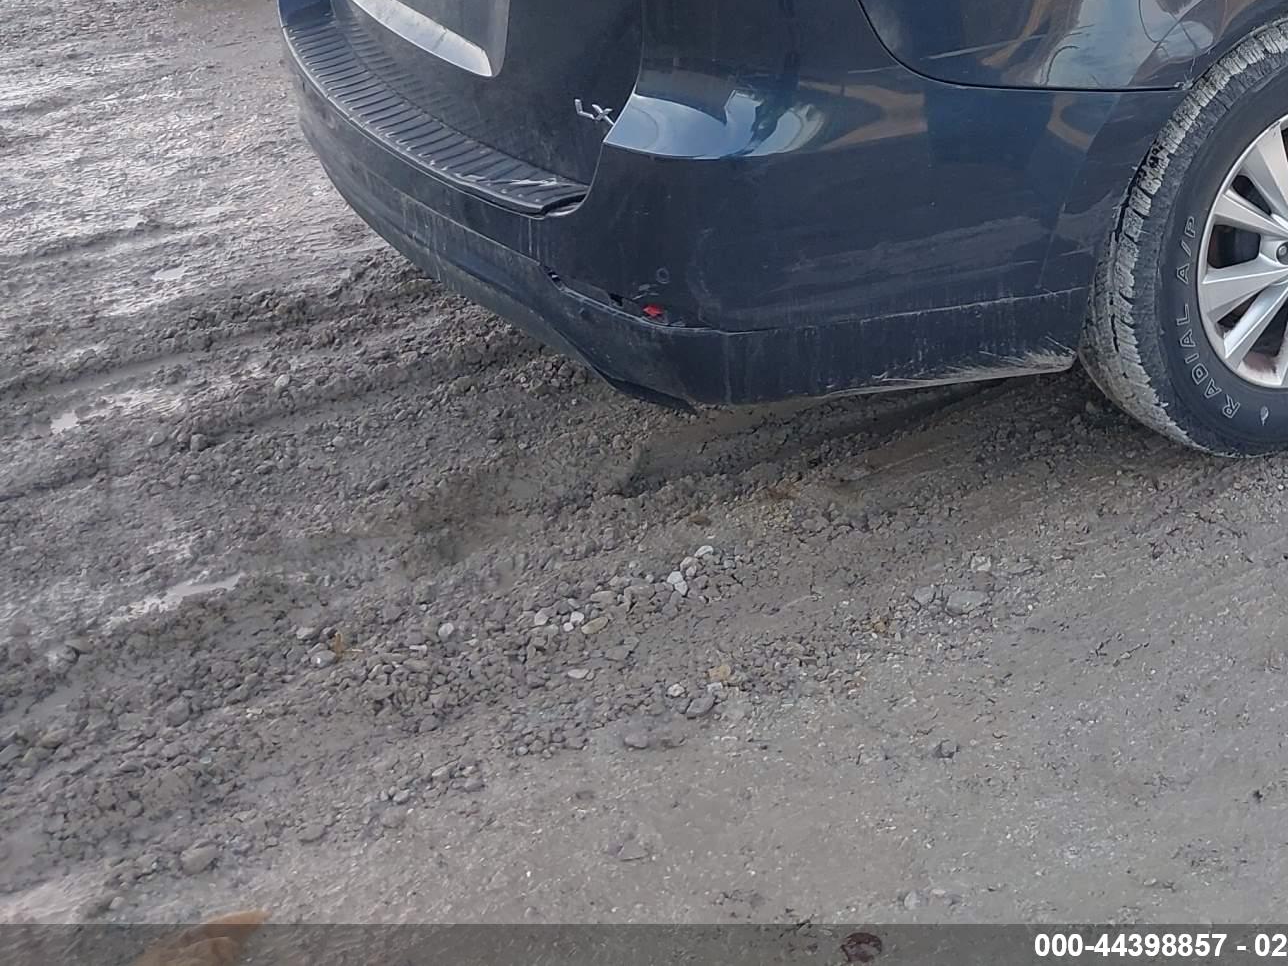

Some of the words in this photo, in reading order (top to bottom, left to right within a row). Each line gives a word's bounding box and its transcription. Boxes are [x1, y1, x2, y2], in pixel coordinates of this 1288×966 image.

[574, 98, 615, 126] LX
[1176, 215, 1196, 284] A/P
[1176, 303, 1241, 419] RADIAL
